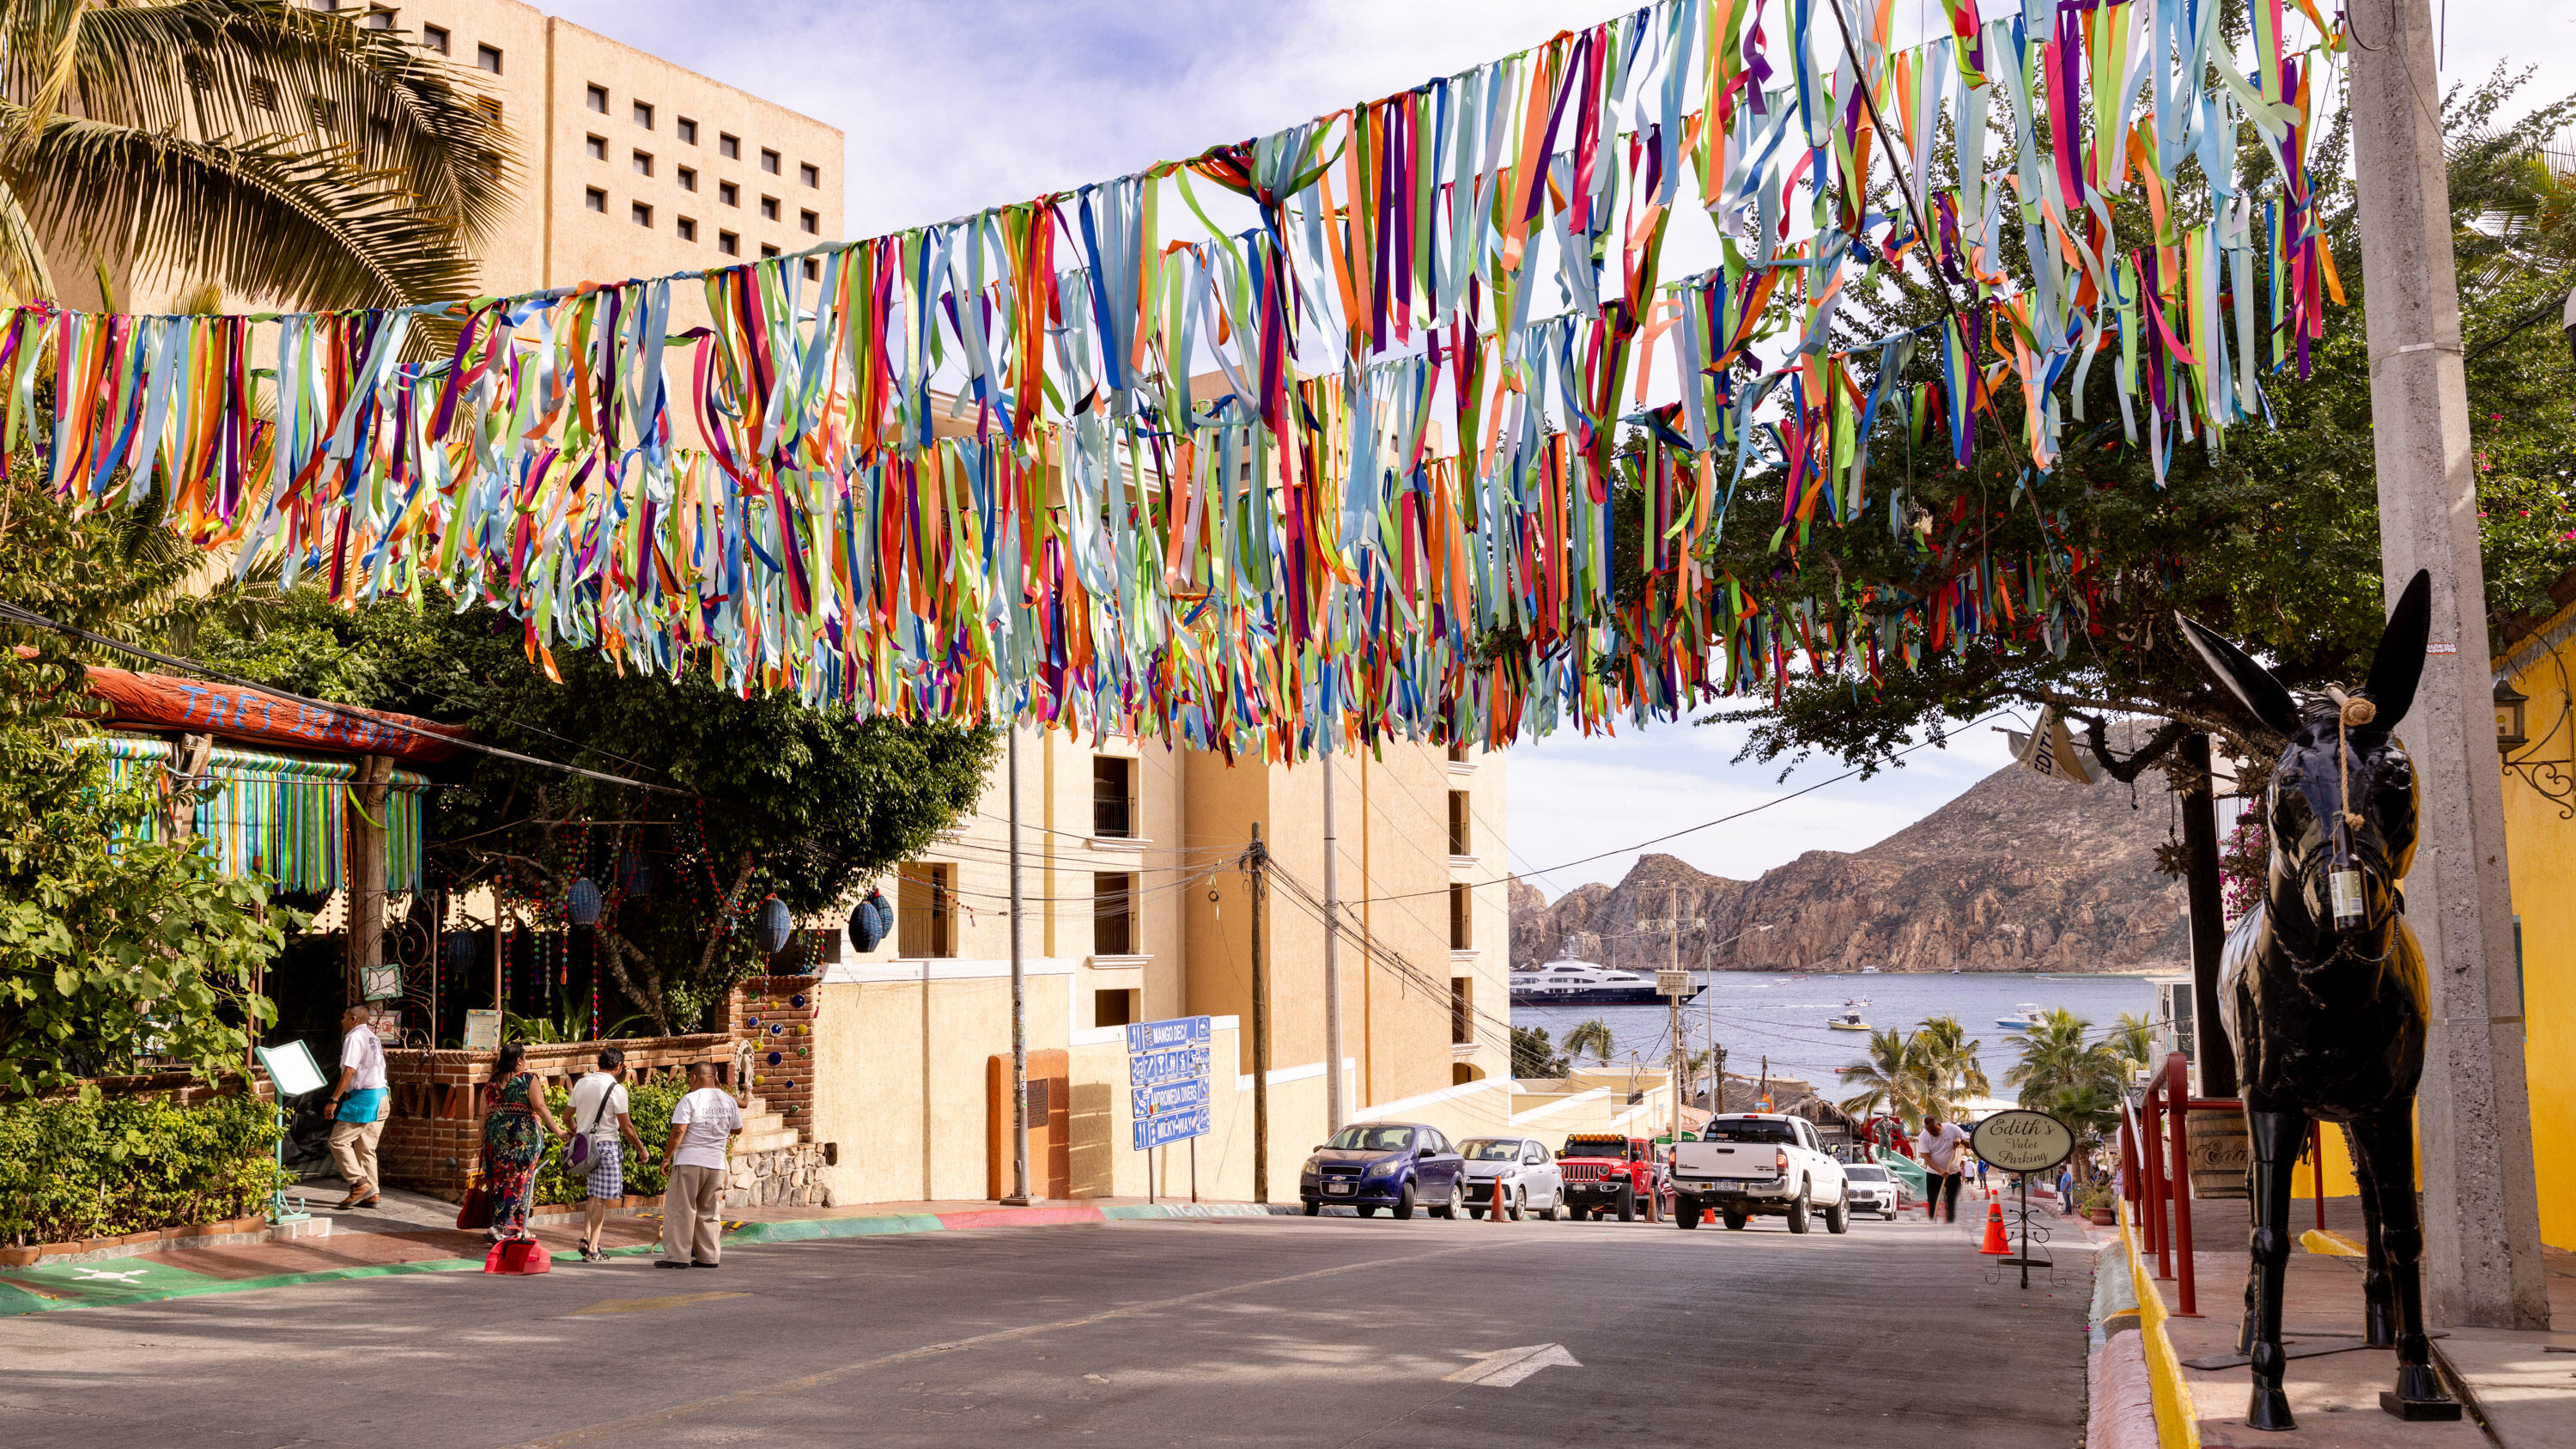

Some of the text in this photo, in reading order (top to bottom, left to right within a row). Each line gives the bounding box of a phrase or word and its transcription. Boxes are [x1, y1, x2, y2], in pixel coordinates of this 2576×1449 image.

[179, 685, 411, 750] TRES SIRENAS
[1152, 1023, 1188, 1044] MANGO DECK
[1181, 1084, 1197, 1103] DIVERS
[1990, 1118, 2055, 1135] Edith's
[2006, 1138, 2038, 1149] Valet
[1998, 1150, 2048, 1166] Parking
